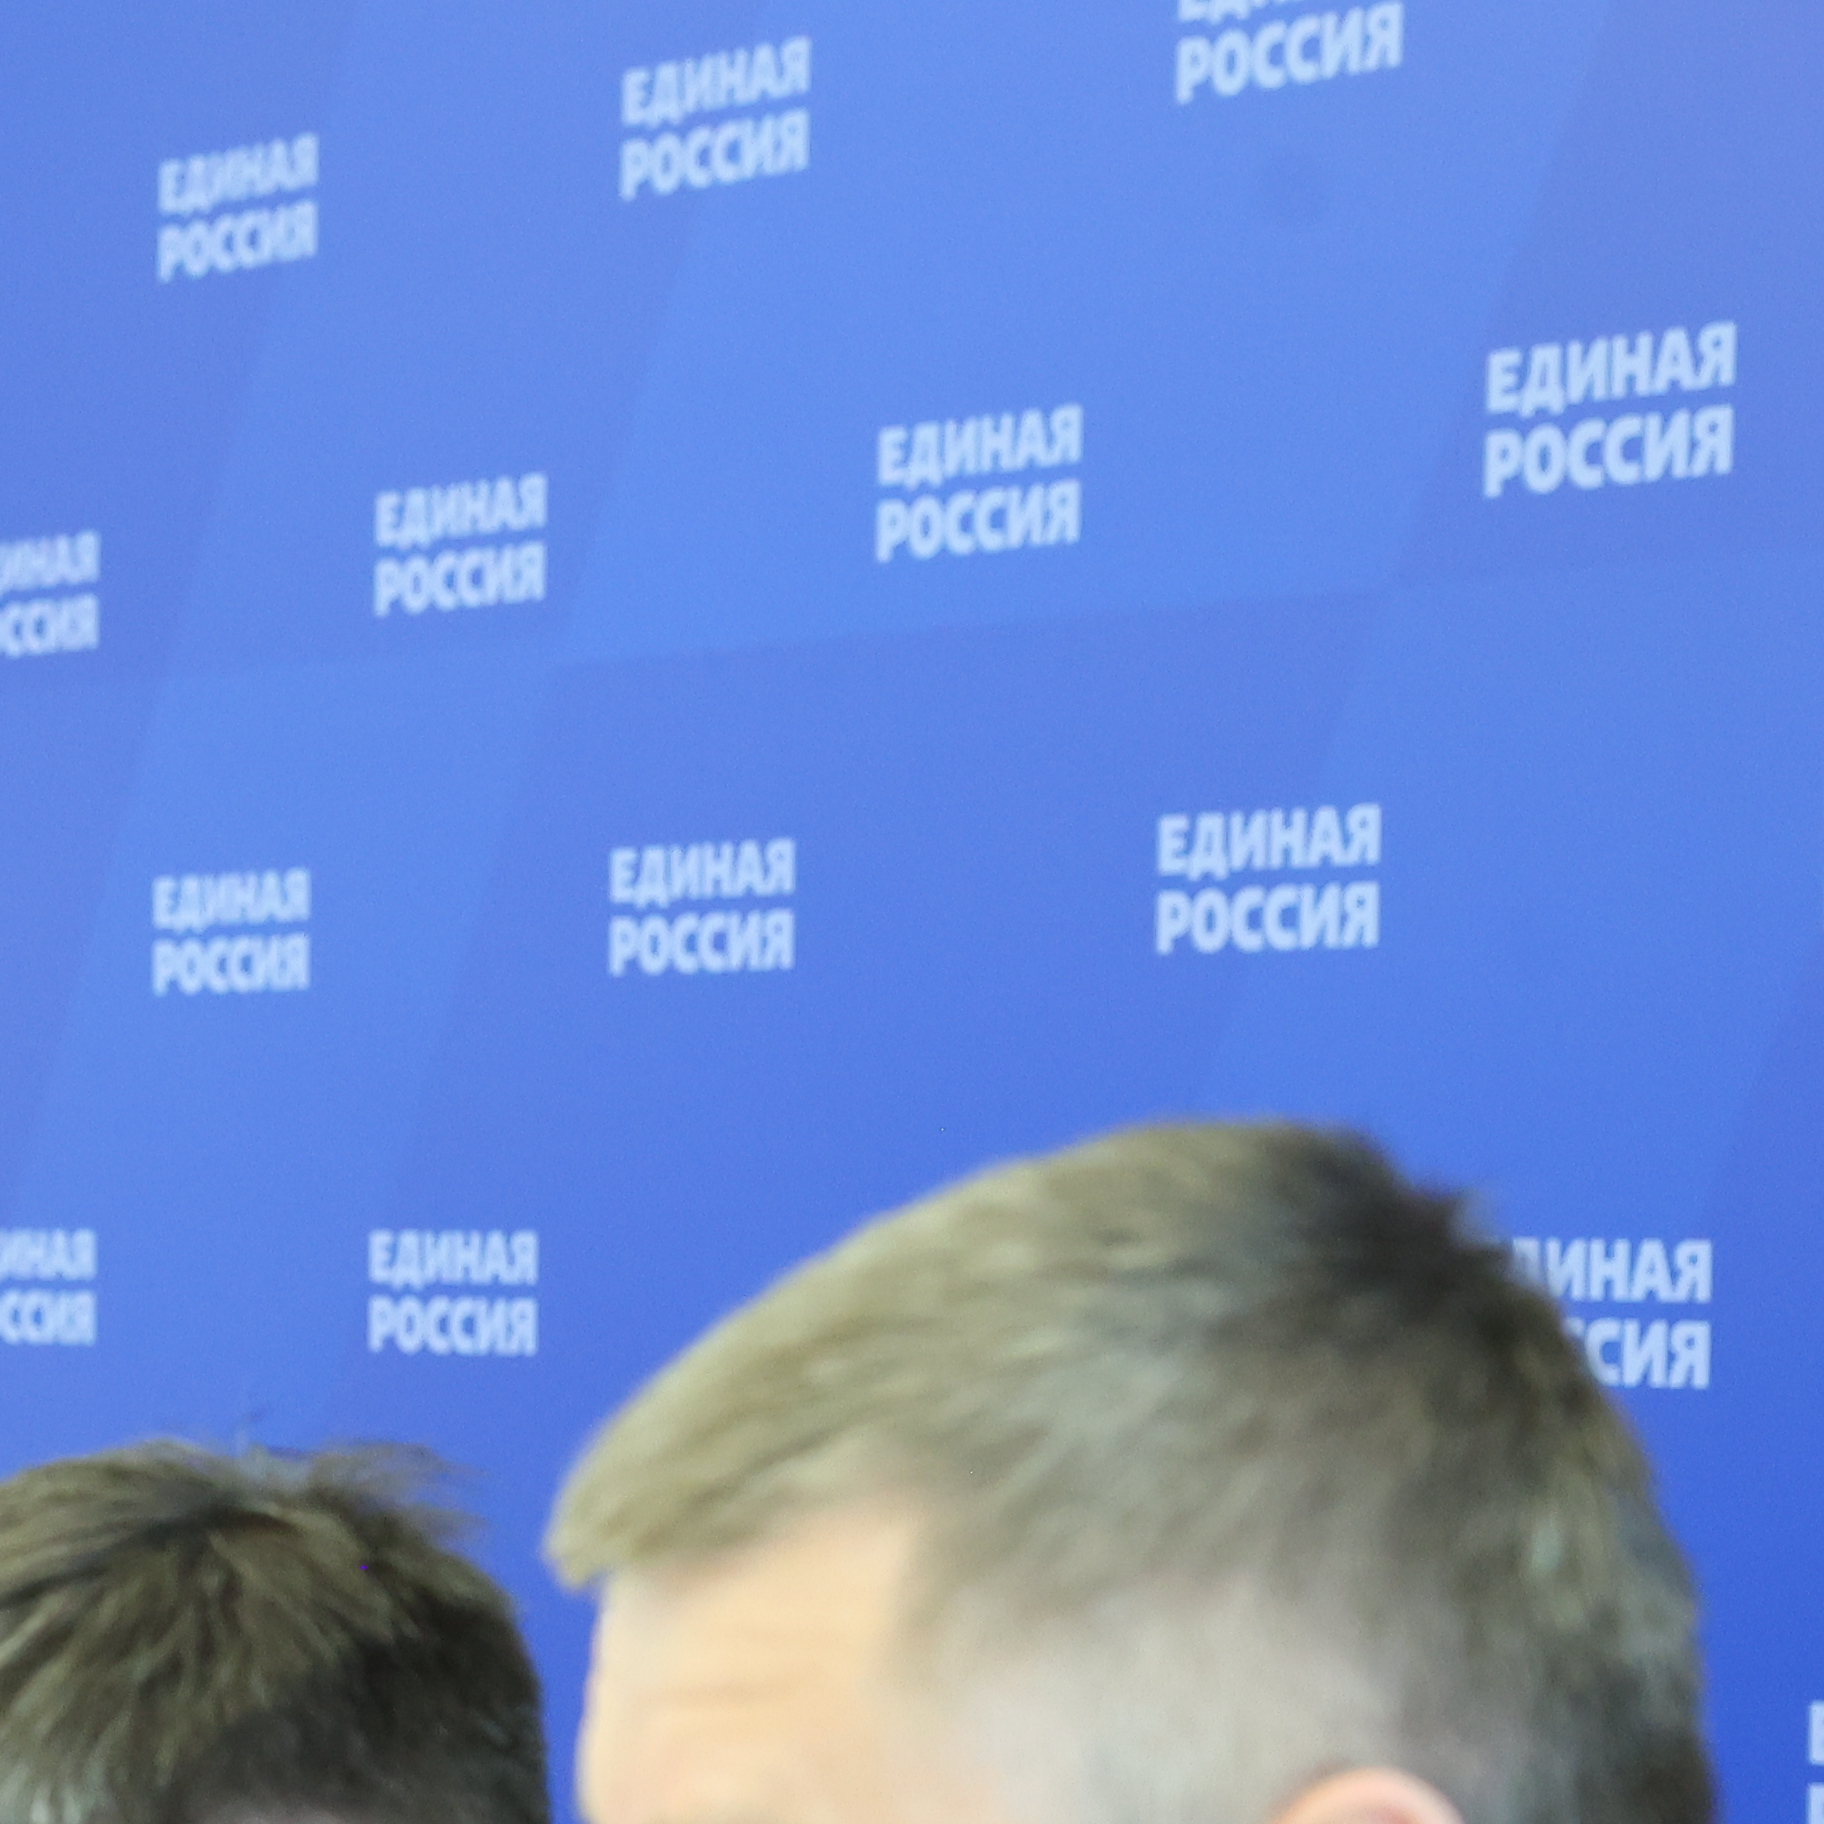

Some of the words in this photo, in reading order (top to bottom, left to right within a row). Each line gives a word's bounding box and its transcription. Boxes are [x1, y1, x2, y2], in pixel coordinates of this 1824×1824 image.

[619, 36, 813, 128] ЕДИНАЯ
[1175, 0, 1405, 104] РОССИЯ
[157, 133, 320, 217] ЕДИНАЯ
[618, 109, 811, 202] РОССИЯ
[157, 201, 319, 283] РОССИЯ
[1484, 322, 1738, 418] ЕДИНАЯ
[876, 404, 1084, 490] ЕДИНАЯ
[1483, 404, 1735, 498] РОССИЯ
[374, 474, 548, 550] ЕДИНАЯ
[874, 478, 1082, 562] РОССИЯ
[373, 541, 547, 616] РОССИЯ
[608, 838, 797, 908] ЕДИНАЯ
[1156, 804, 1383, 881] ЕДИНАЯ
[151, 868, 312, 933] ЕДИНАЯ
[1155, 882, 1381, 954] РОССИЯ
[151, 932, 311, 995] РОССИЯ
[608, 909, 796, 976] РОССИЯ
[367, 1229, 539, 1290] ЕДИНАЯ
[1512, 1237, 1713, 1303] ИНАЯ
[367, 1295, 538, 1355] РОССИЯ
[1564, 1318, 1710, 1389] СИЯ
